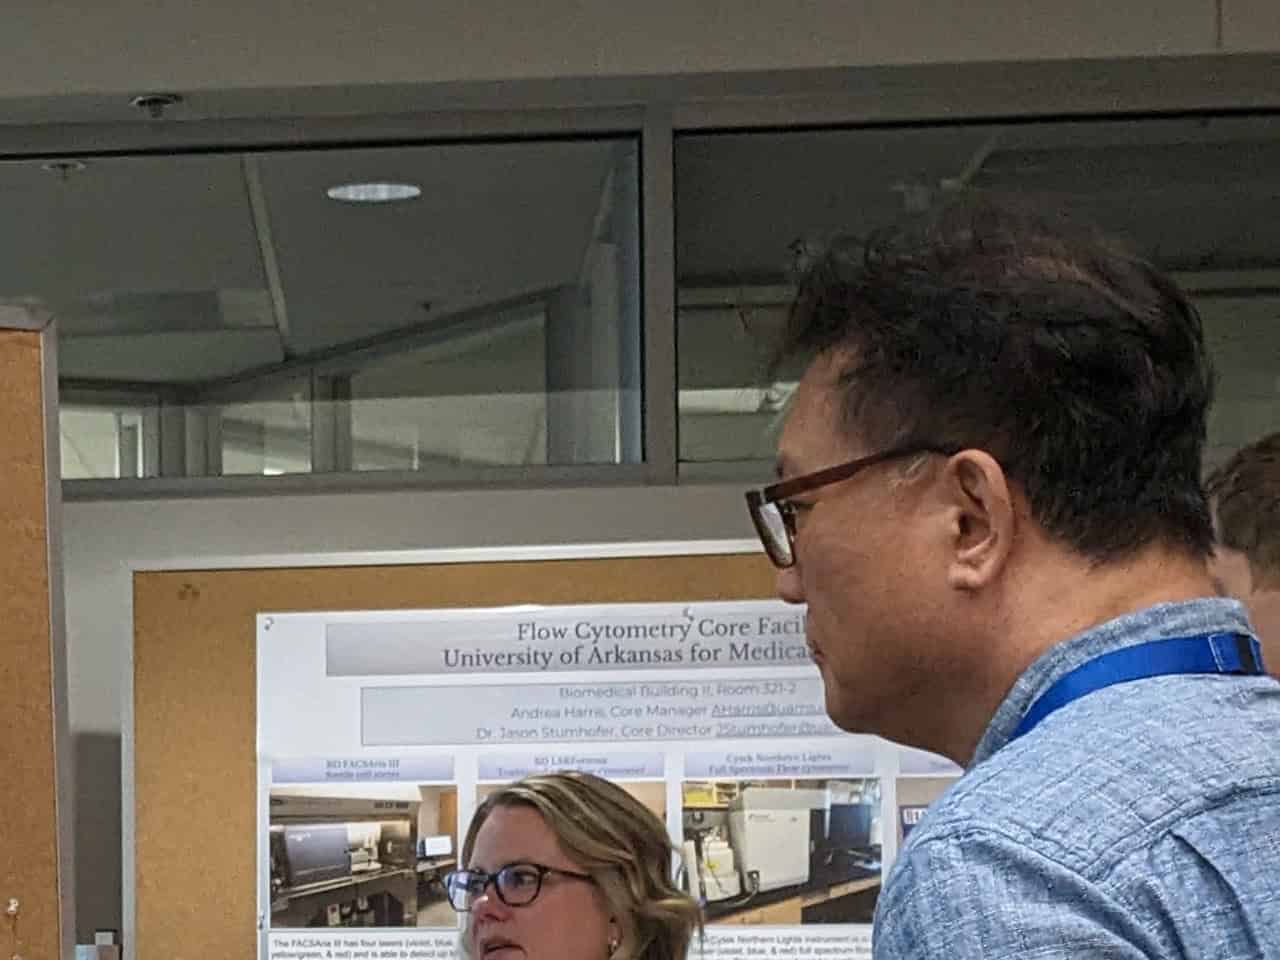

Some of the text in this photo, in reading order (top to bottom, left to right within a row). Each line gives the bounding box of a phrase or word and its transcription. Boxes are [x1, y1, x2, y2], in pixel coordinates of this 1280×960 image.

[518, 622, 567, 642] Flow
[575, 619, 691, 645] Cytometry
[698, 618, 750, 638] Core
[444, 640, 808, 671] University of Arkansas for Medica
[559, 686, 636, 699] Biomedical
[640, 684, 701, 700] Building
[717, 684, 759, 697] Room
[510, 707, 560, 720] Andrea
[611, 705, 643, 719] Core
[647, 704, 707, 721] Manager
[500, 726, 537, 739] Jason
[621, 724, 654, 738] Core
[657, 722, 712, 737] Director
